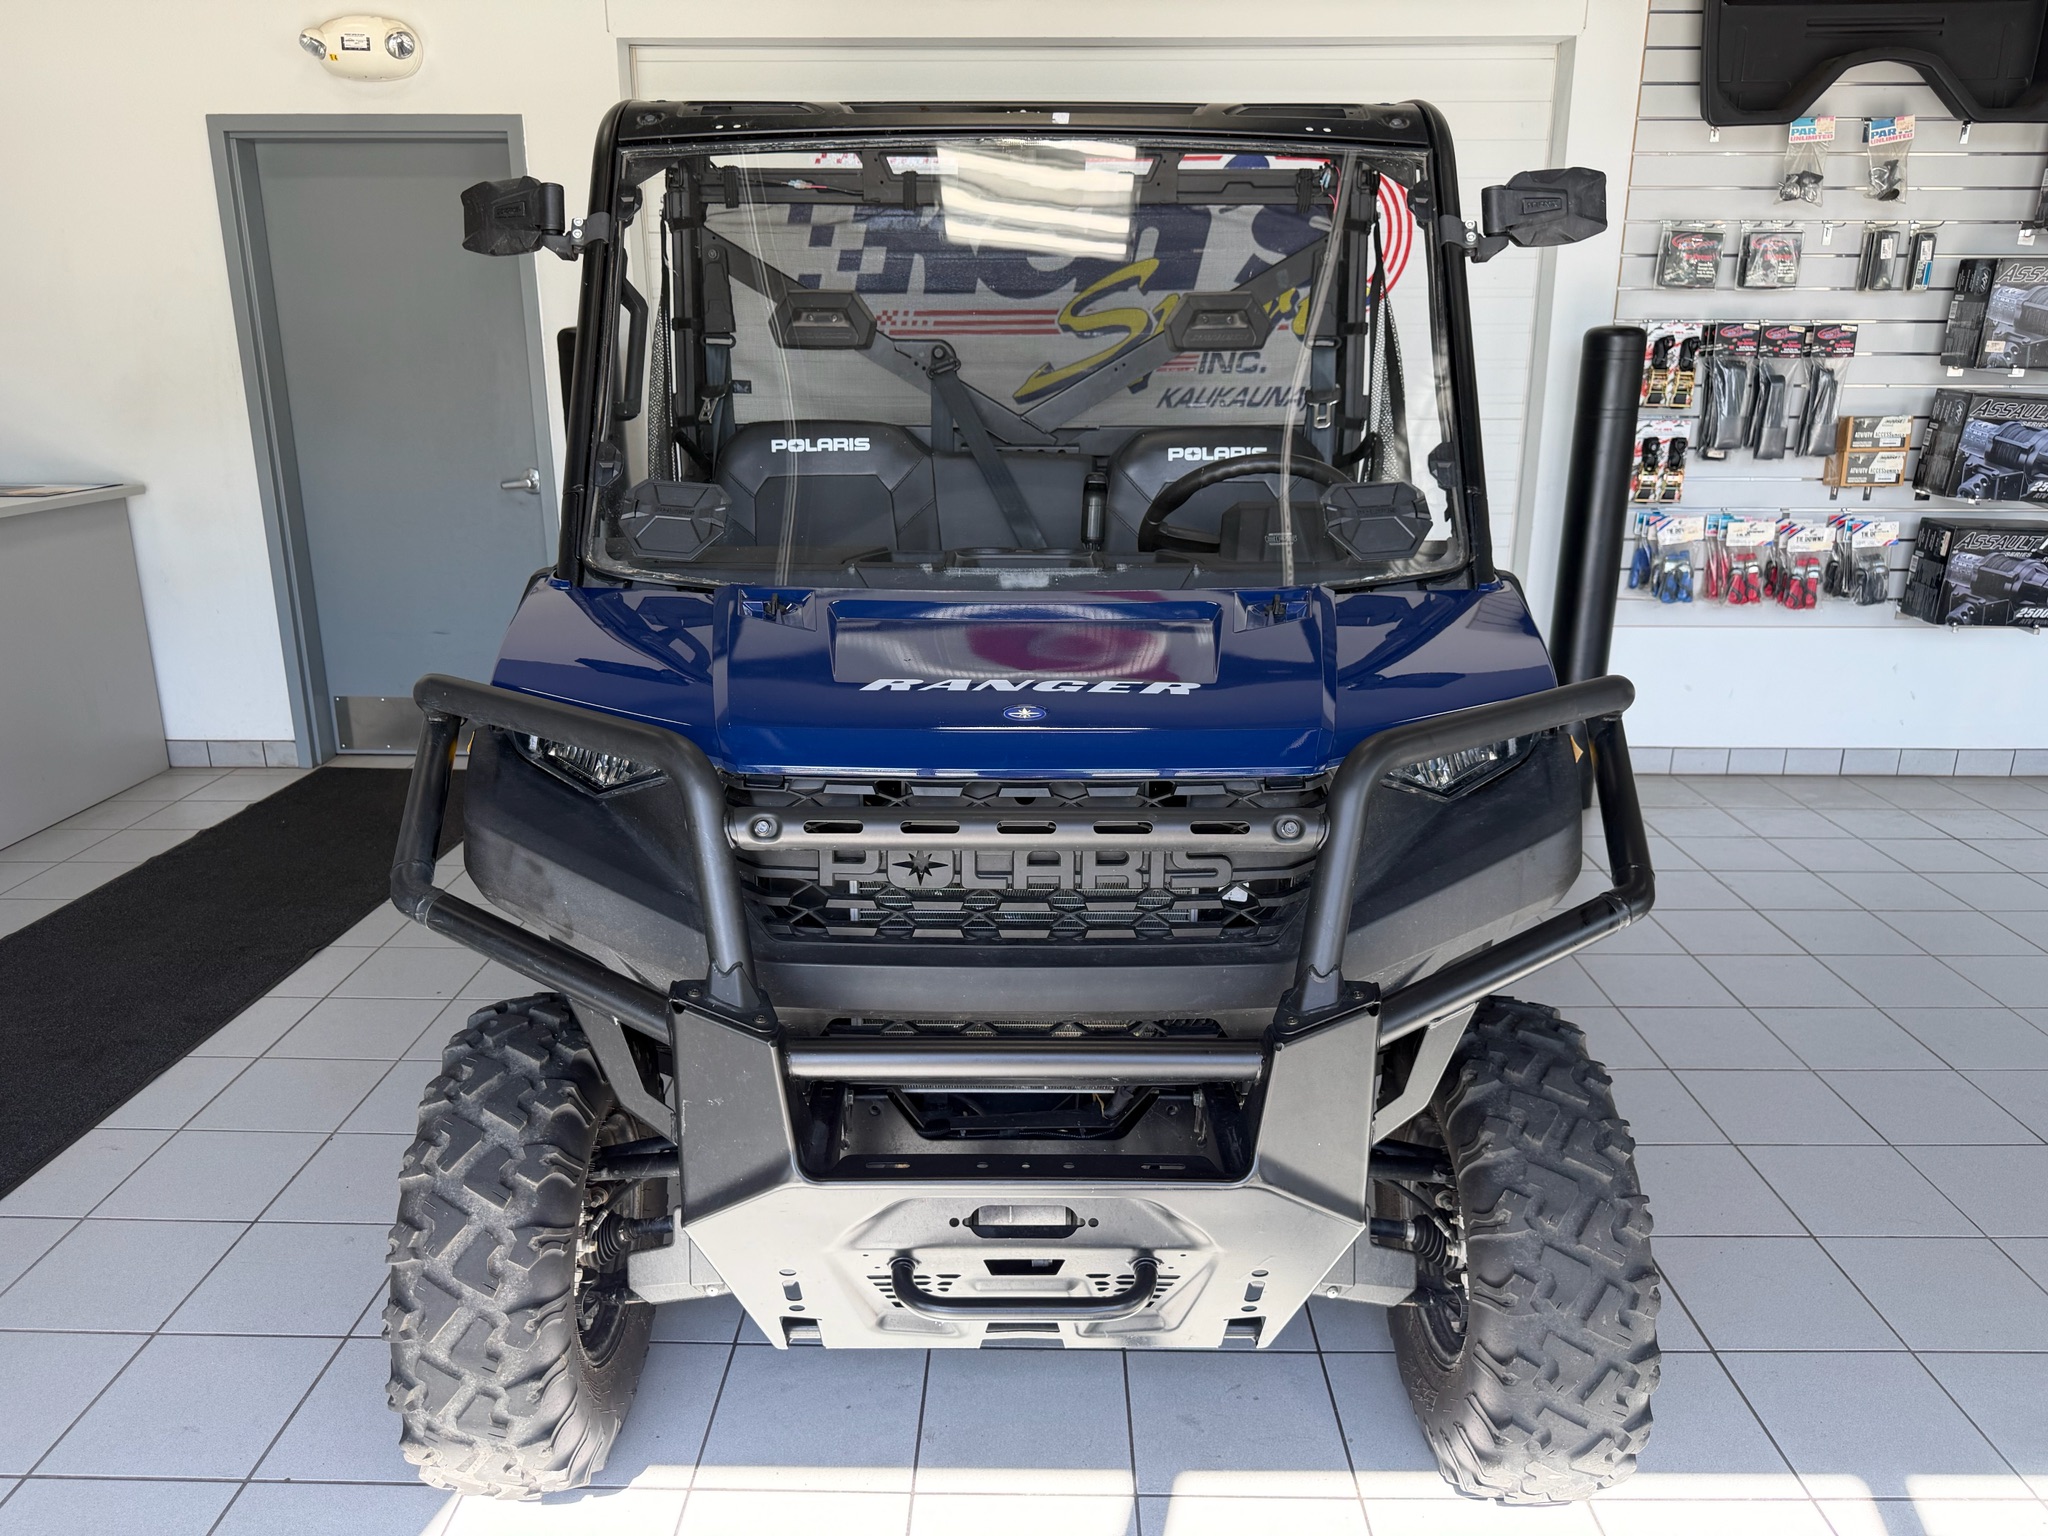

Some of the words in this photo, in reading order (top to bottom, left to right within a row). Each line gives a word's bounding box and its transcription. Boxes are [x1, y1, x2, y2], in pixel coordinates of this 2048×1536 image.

[1790, 134, 1833, 142] UNLIMITED
[1870, 133, 1913, 145] UNLIMITED
[1198, 351, 1267, 375] INC.
[1970, 399, 2048, 420] ASSAUL
[771, 437, 871, 453] POLARIS
[1954, 531, 2044, 551] ASSAULT
[859, 678, 1201, 695] RANGER
[818, 849, 1233, 888] POLARIS
